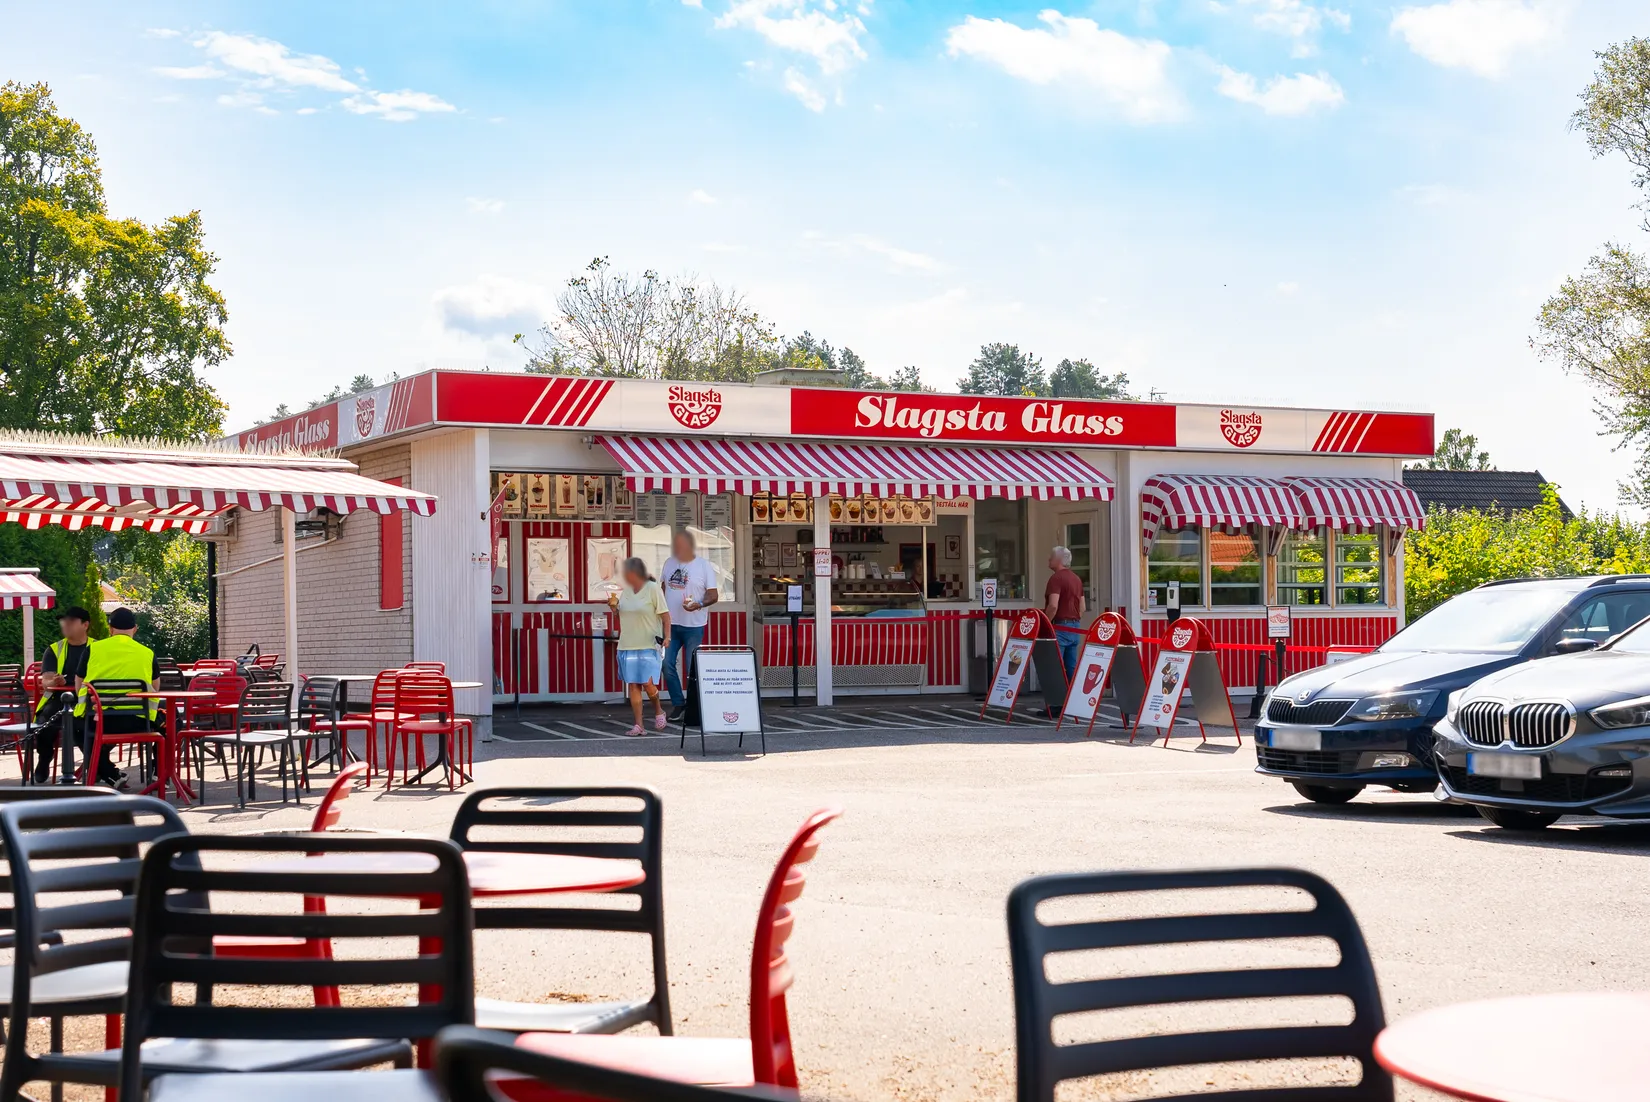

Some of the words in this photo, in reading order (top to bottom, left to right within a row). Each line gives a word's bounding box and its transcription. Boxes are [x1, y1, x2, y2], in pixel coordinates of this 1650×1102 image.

[669, 386, 721, 408] Slagsta
[674, 405, 717, 426] GLASS
[855, 395, 1007, 437] Slagsta
[1021, 402, 1124, 436] Glass
[1220, 409, 1262, 429] Slagsta
[294, 416, 330, 448] Glass
[1225, 427, 1258, 444] GLASS
